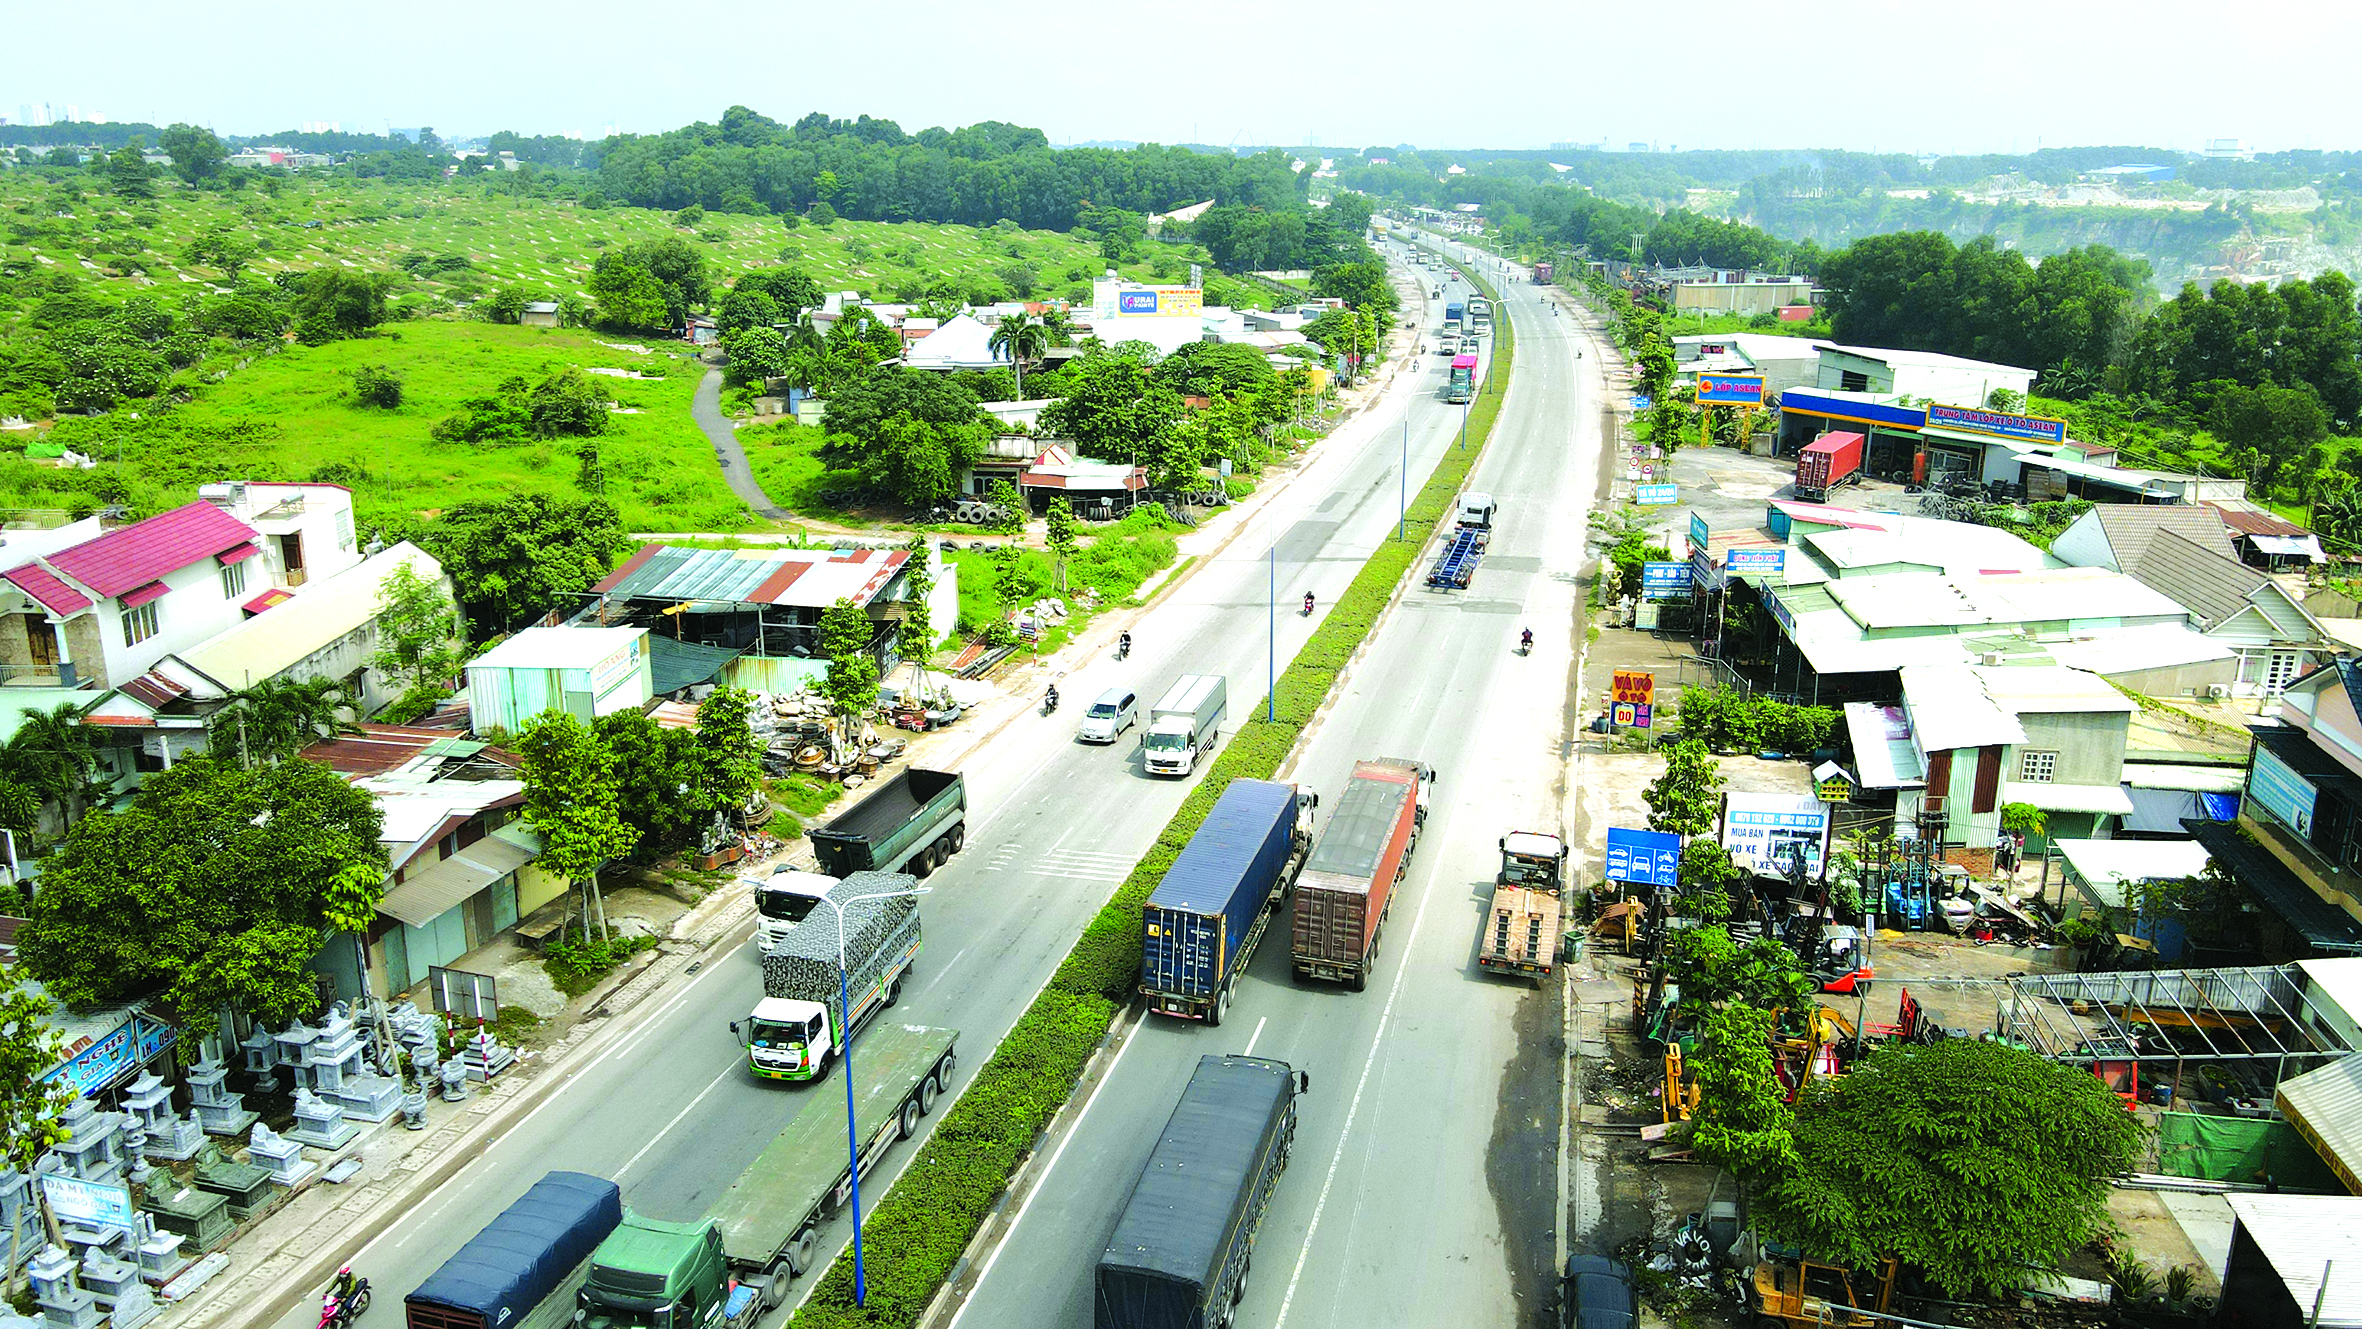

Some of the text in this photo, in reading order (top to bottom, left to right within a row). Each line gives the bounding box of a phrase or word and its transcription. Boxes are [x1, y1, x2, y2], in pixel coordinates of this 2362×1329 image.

[1733, 384, 1762, 392] ASEAN
[1935, 408, 1960, 418] TRUNG
[1962, 410, 1978, 421] TÂM
[1995, 415, 2005, 425] XE
[2006, 415, 2013, 426] Ô
[2015, 417, 2026, 428] TÔ
[2028, 420, 2057, 432] ASEAN
[1614, 673, 1652, 691] VÁ VỎ
[1618, 690, 1629, 702] Ô
[1618, 710, 1632, 721] DO
[1730, 827, 1764, 838] MUA BÁN
[1745, 844, 1757, 854] XE
[81, 1062, 105, 1080] GIA
